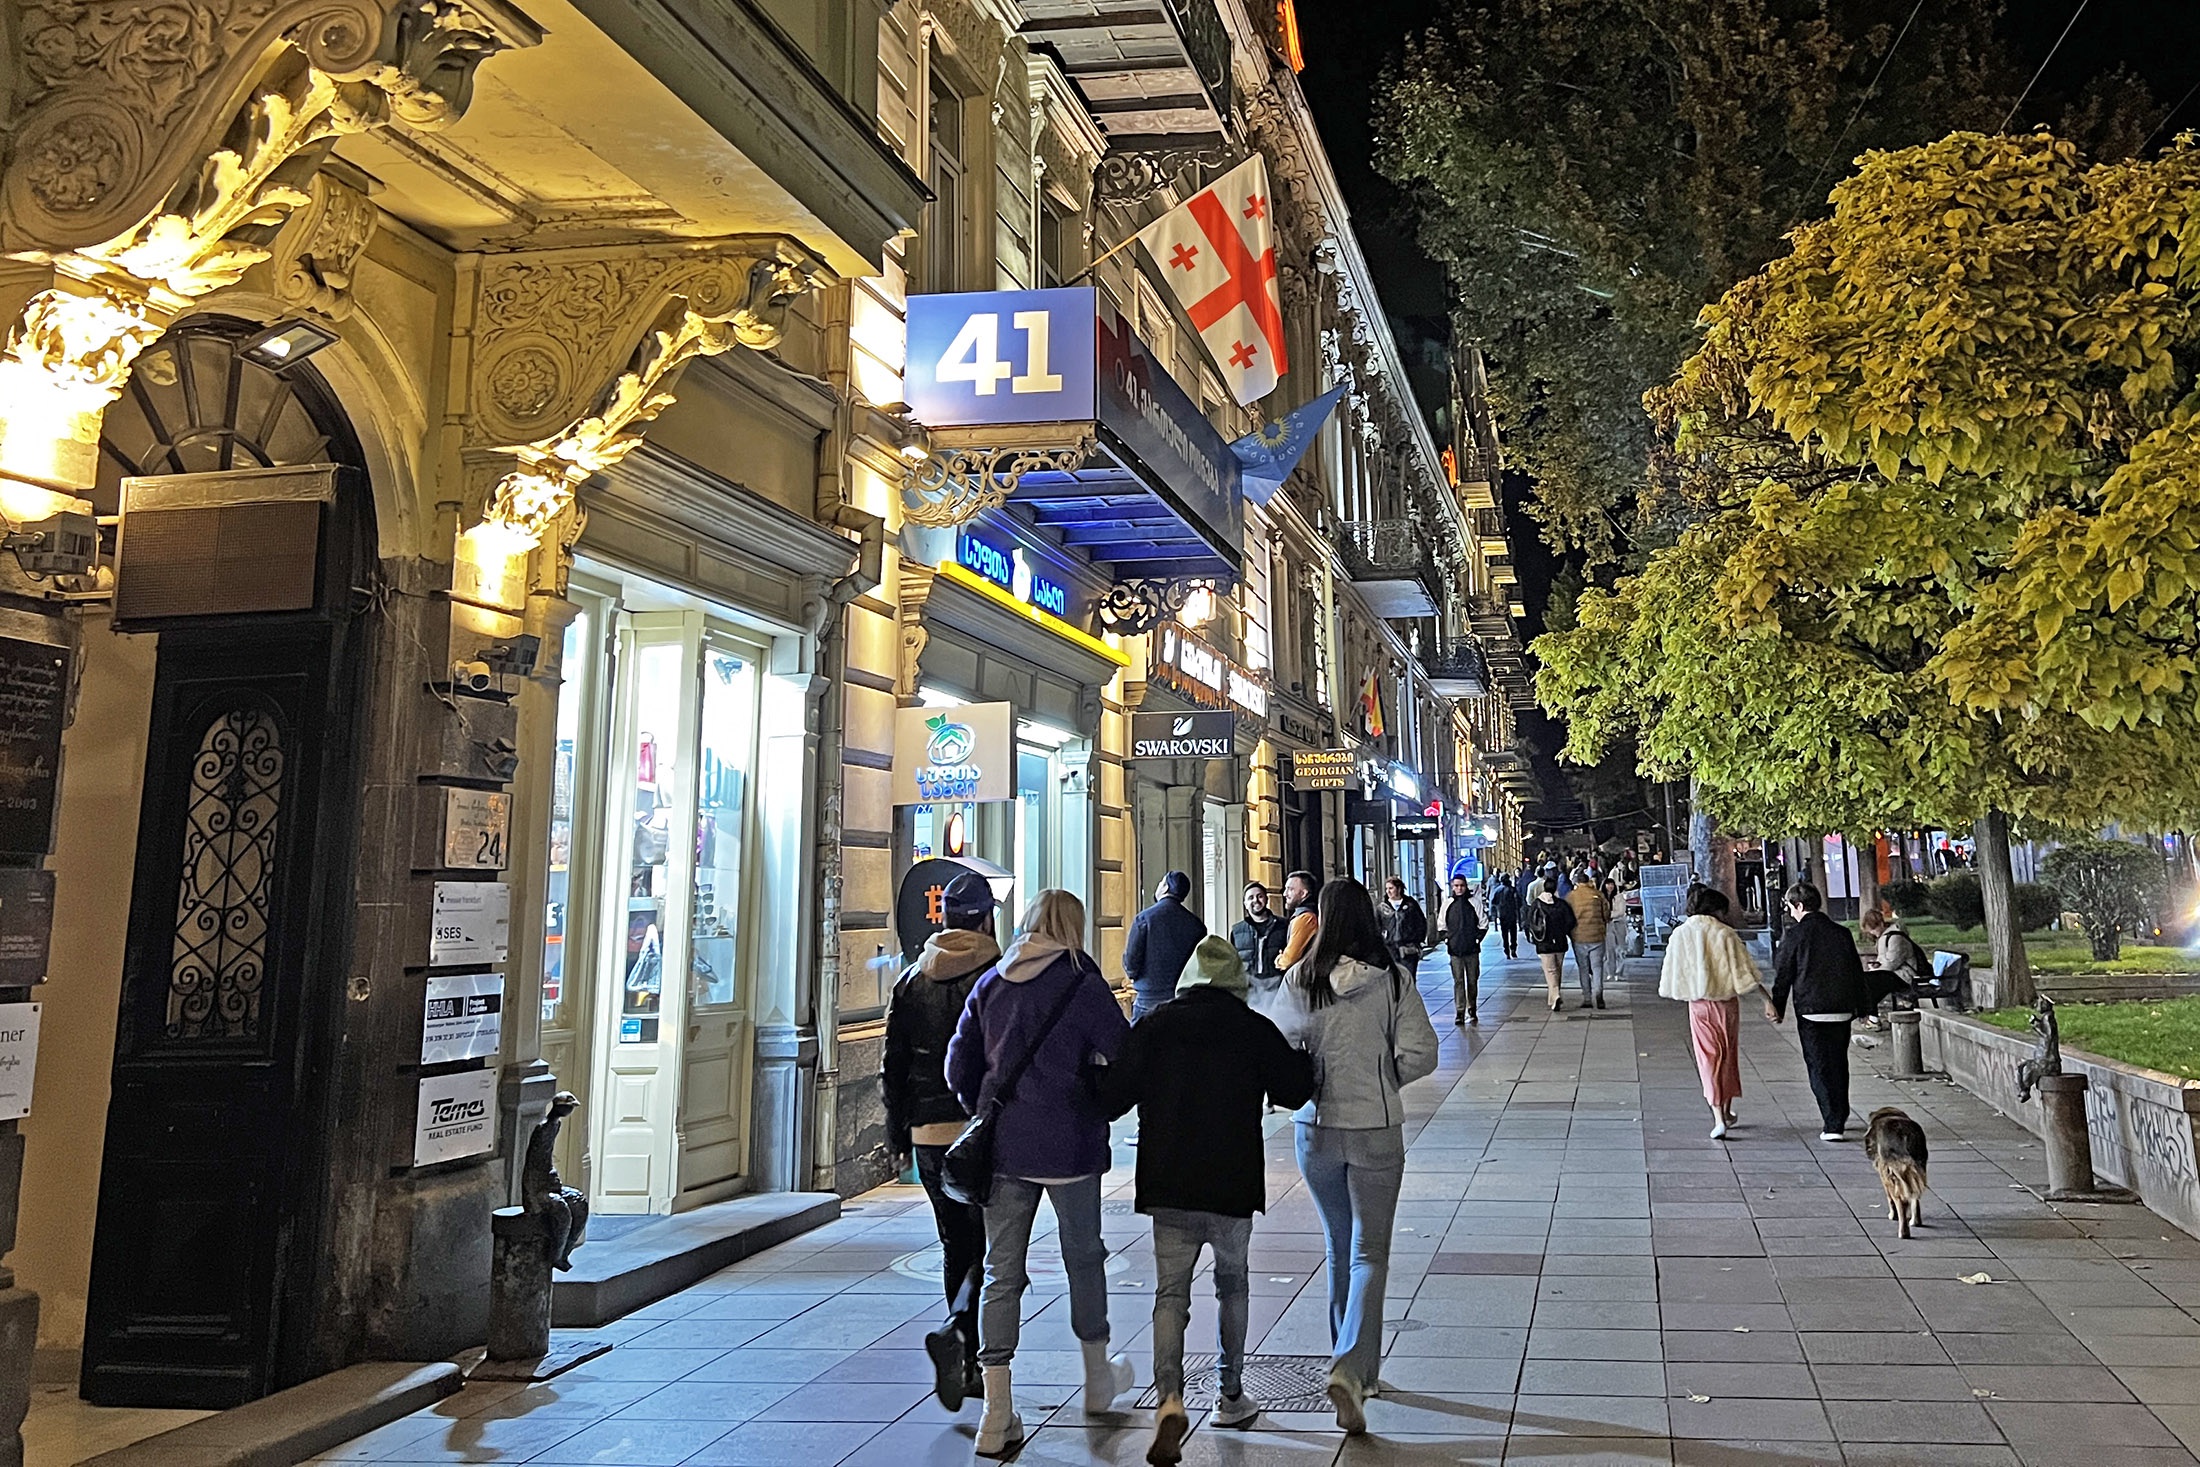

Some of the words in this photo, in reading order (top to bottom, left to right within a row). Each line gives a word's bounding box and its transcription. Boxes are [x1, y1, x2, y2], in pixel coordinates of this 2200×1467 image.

[936, 311, 1062, 395] 41
[1126, 370, 1139, 409] 41
[965, 535, 1008, 583] სუფთა
[1034, 575, 1064, 615] სახლი
[1135, 739, 1229, 756] SWAROVSKI
[915, 764, 982, 784] სუფთა
[1294, 766, 1354, 777] GEORGIAN
[920, 780, 977, 800] სახლი
[1311, 778, 1345, 788] GIFTS
[476, 831, 502, 865] 24
[443, 927, 461, 939] SES
[428, 1000, 454, 1018] HHLA
[428, 1132, 443, 1141] REAL
[445, 1126, 466, 1137] ESTATE
[467, 1123, 483, 1133] FUND
